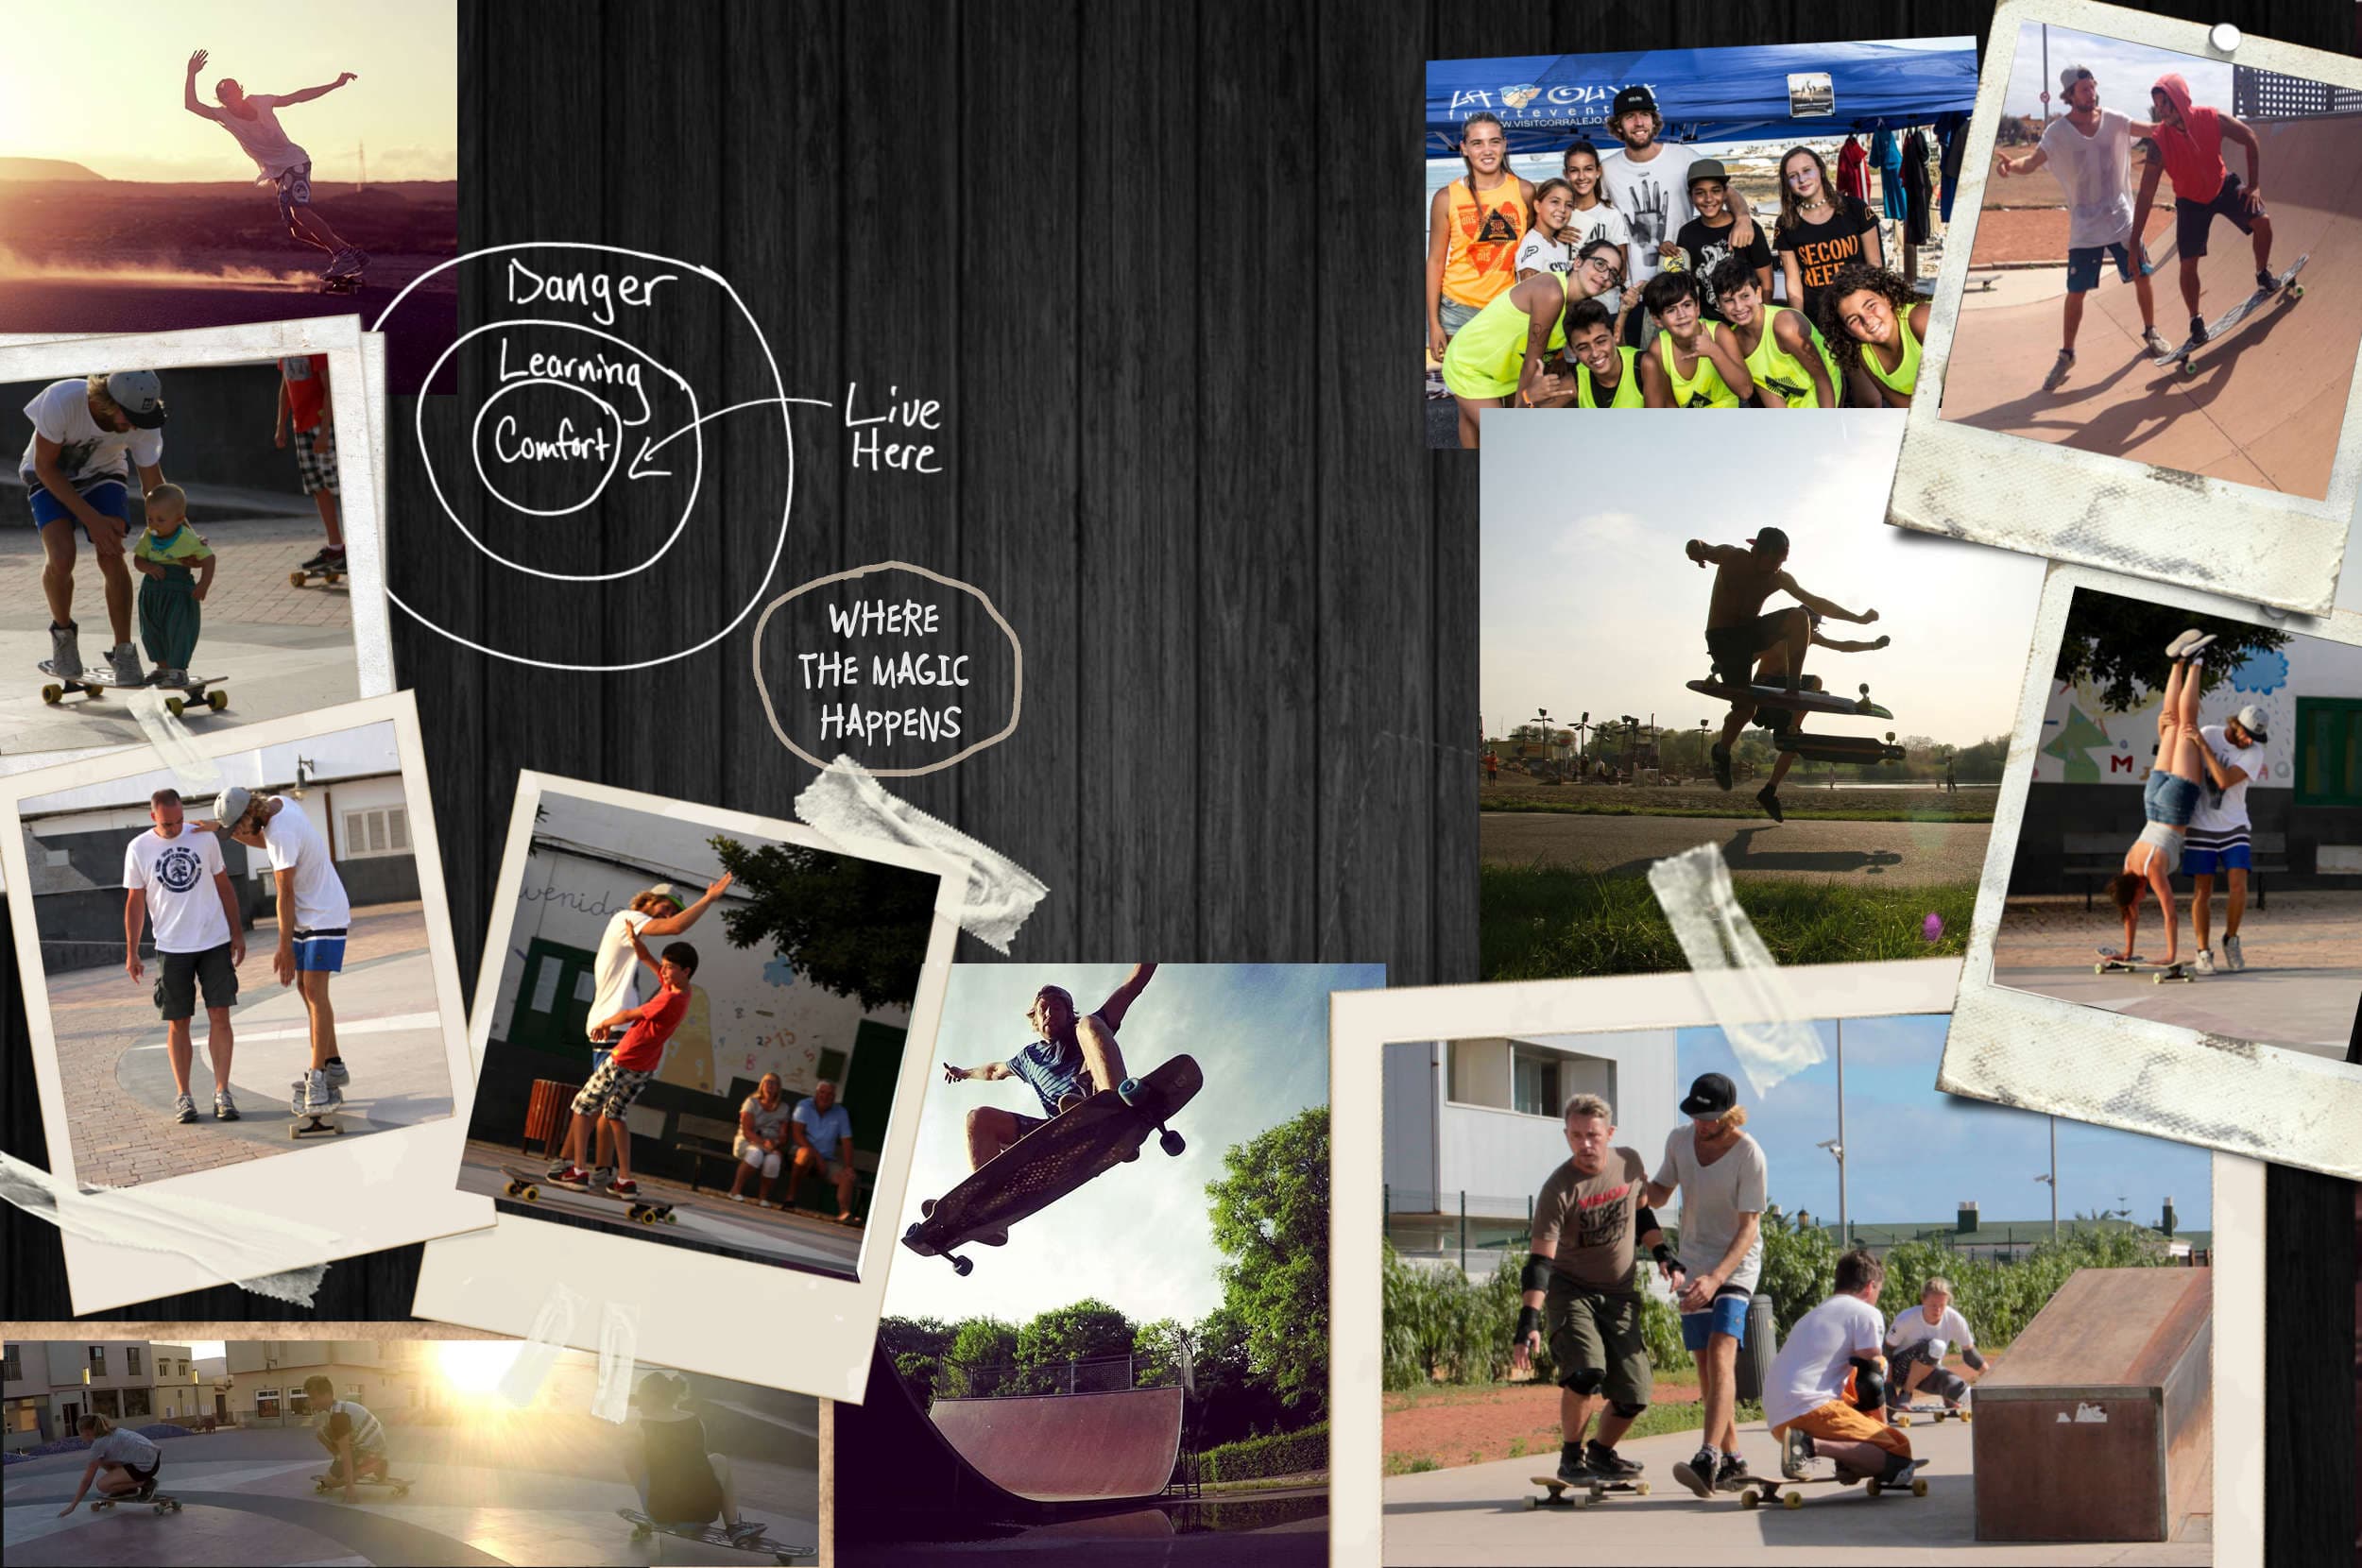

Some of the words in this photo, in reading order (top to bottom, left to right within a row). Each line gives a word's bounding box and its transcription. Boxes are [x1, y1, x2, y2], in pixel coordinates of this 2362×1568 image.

[508, 258, 678, 325] Danger
[499, 337, 651, 426] Learning
[845, 382, 941, 430] Live
[495, 415, 611, 463] Comfort
[852, 431, 943, 473] Here
[829, 599, 940, 639] WHERE
[798, 653, 858, 690] THE
[872, 652, 970, 690] MAGIC
[820, 705, 963, 747] HAPPENS
